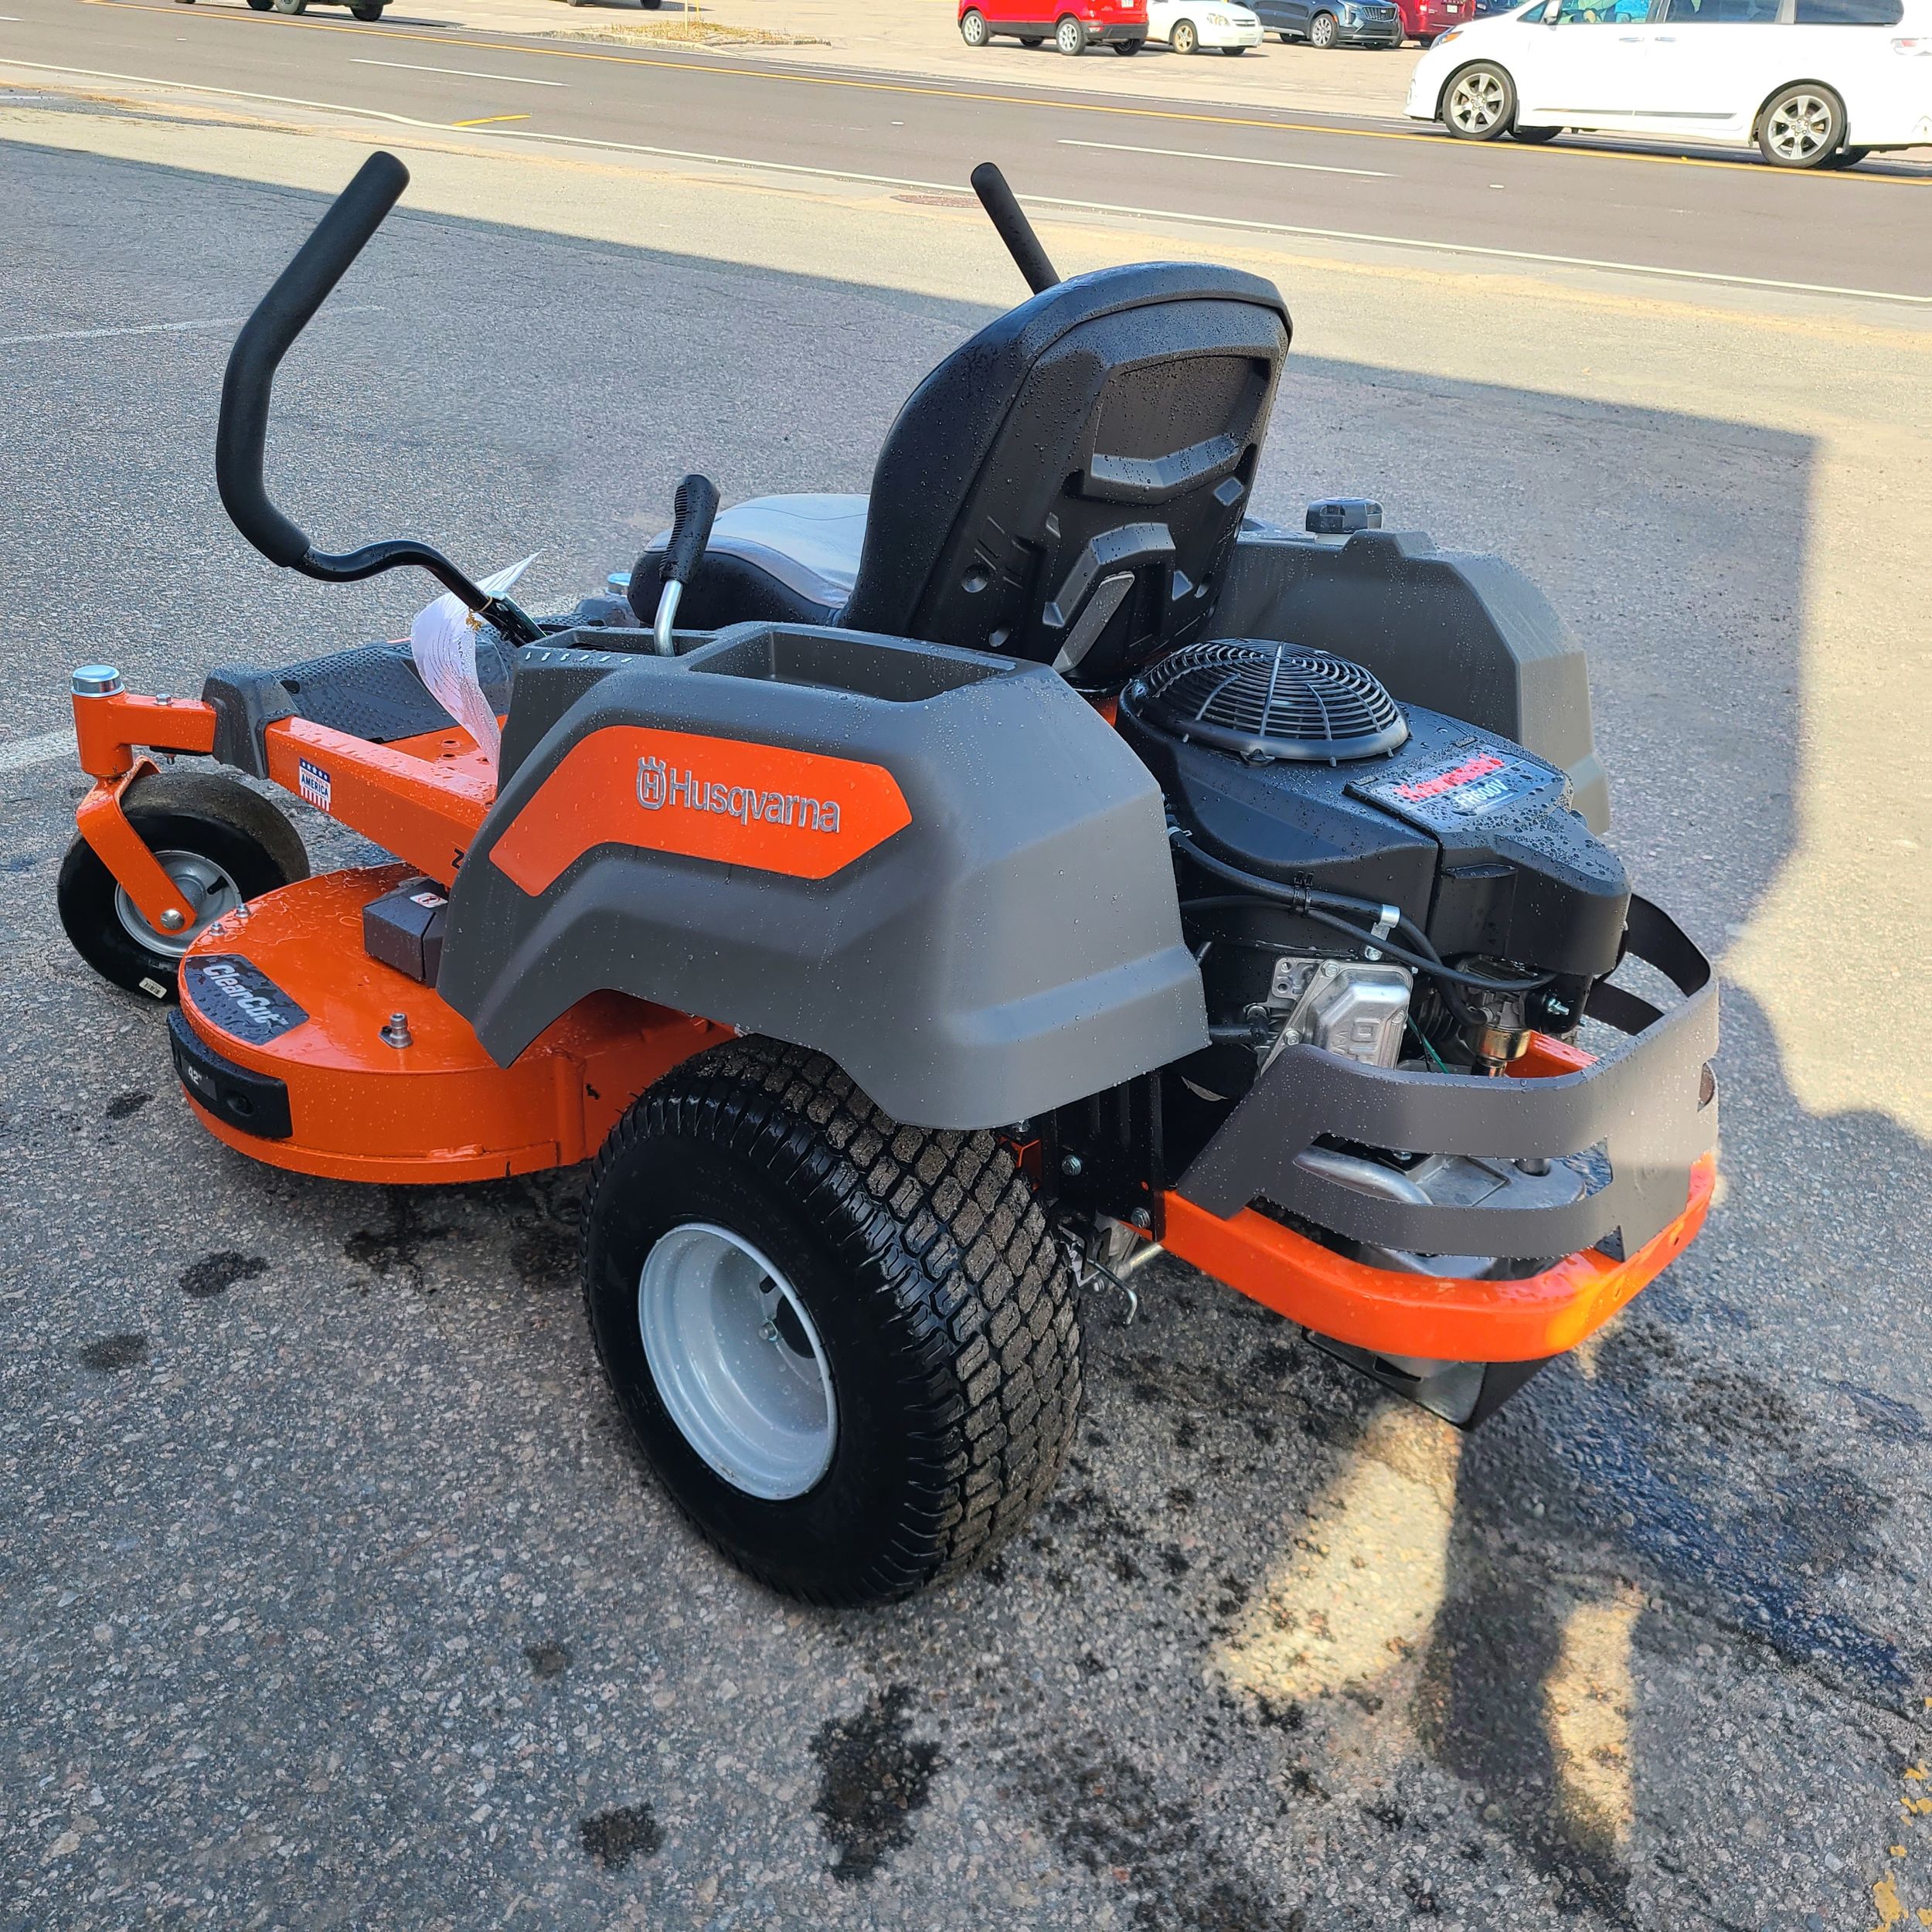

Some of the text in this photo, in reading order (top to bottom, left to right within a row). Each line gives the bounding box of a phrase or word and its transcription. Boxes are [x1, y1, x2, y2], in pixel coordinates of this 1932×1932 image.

[301, 774, 328, 797] AMERICA
[669, 767, 840, 833] Husqvarna
[1453, 778, 1509, 808] FR600V
